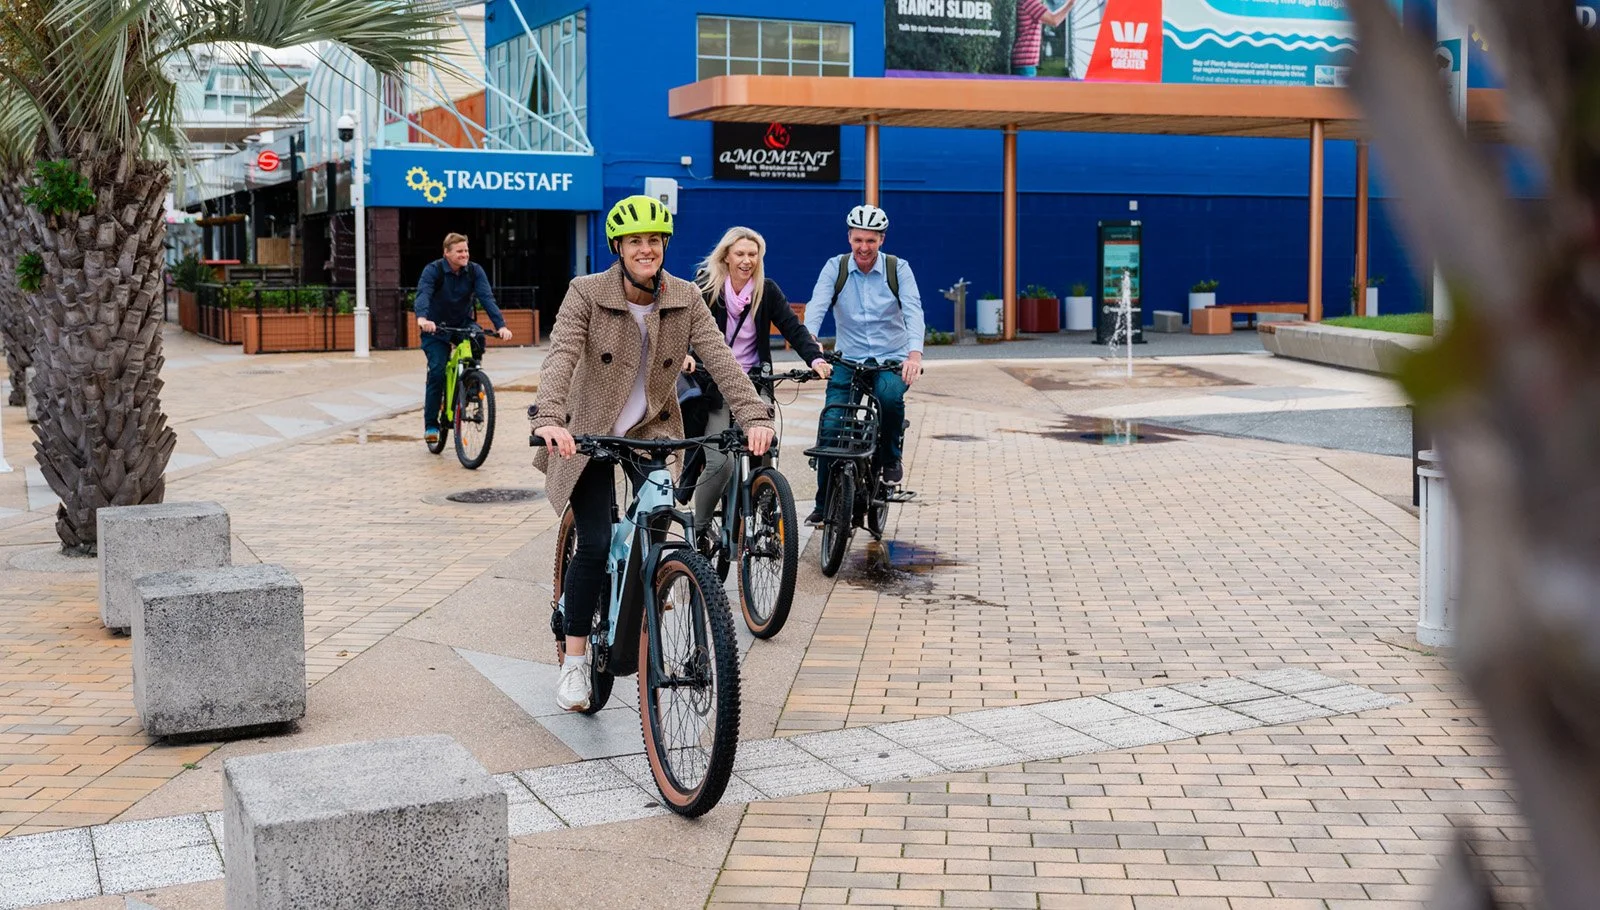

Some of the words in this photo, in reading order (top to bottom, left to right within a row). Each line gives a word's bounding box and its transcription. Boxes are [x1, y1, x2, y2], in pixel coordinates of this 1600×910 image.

[897, 0, 945, 17] RANCH
[946, 0, 992, 20] SLIDER
[898, 23, 910, 31] Talk
[910, 24, 918, 32] to
[917, 25, 928, 33] our
[927, 24, 944, 33] home
[943, 26, 964, 36] lending
[985, 28, 1001, 38] today
[1109, 47, 1149, 60] TOGETHER
[1111, 58, 1146, 70] GREATER
[1192, 58, 1203, 67] Bay
[1209, 60, 1227, 68] Plenty
[1227, 60, 1250, 69] Regional
[1249, 61, 1269, 70] Council
[1223, 68, 1255, 76] environment
[443, 169, 573, 192] TRADESTAFF
